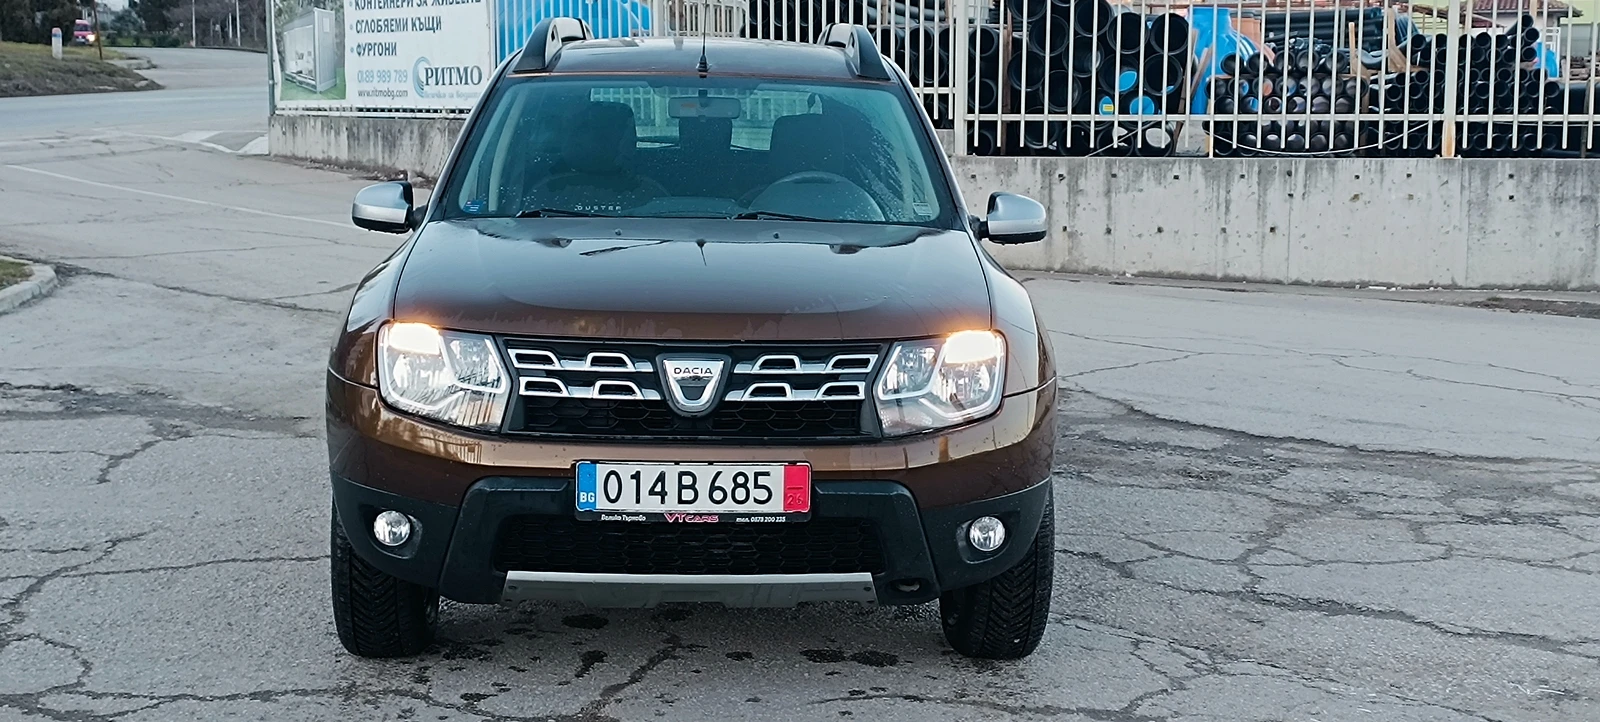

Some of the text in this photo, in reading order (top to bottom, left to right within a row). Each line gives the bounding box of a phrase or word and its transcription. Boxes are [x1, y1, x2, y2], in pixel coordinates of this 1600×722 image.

[355, 16, 442, 34] СГЛОБЯЕМИ КЪЩИ
[355, 42, 397, 57] ФУРГОНИ
[424, 65, 482, 86] РИТМО
[673, 367, 713, 375] DACIA
[580, 469, 773, 505] BG 014 B 685
[786, 493, 804, 505] 26
